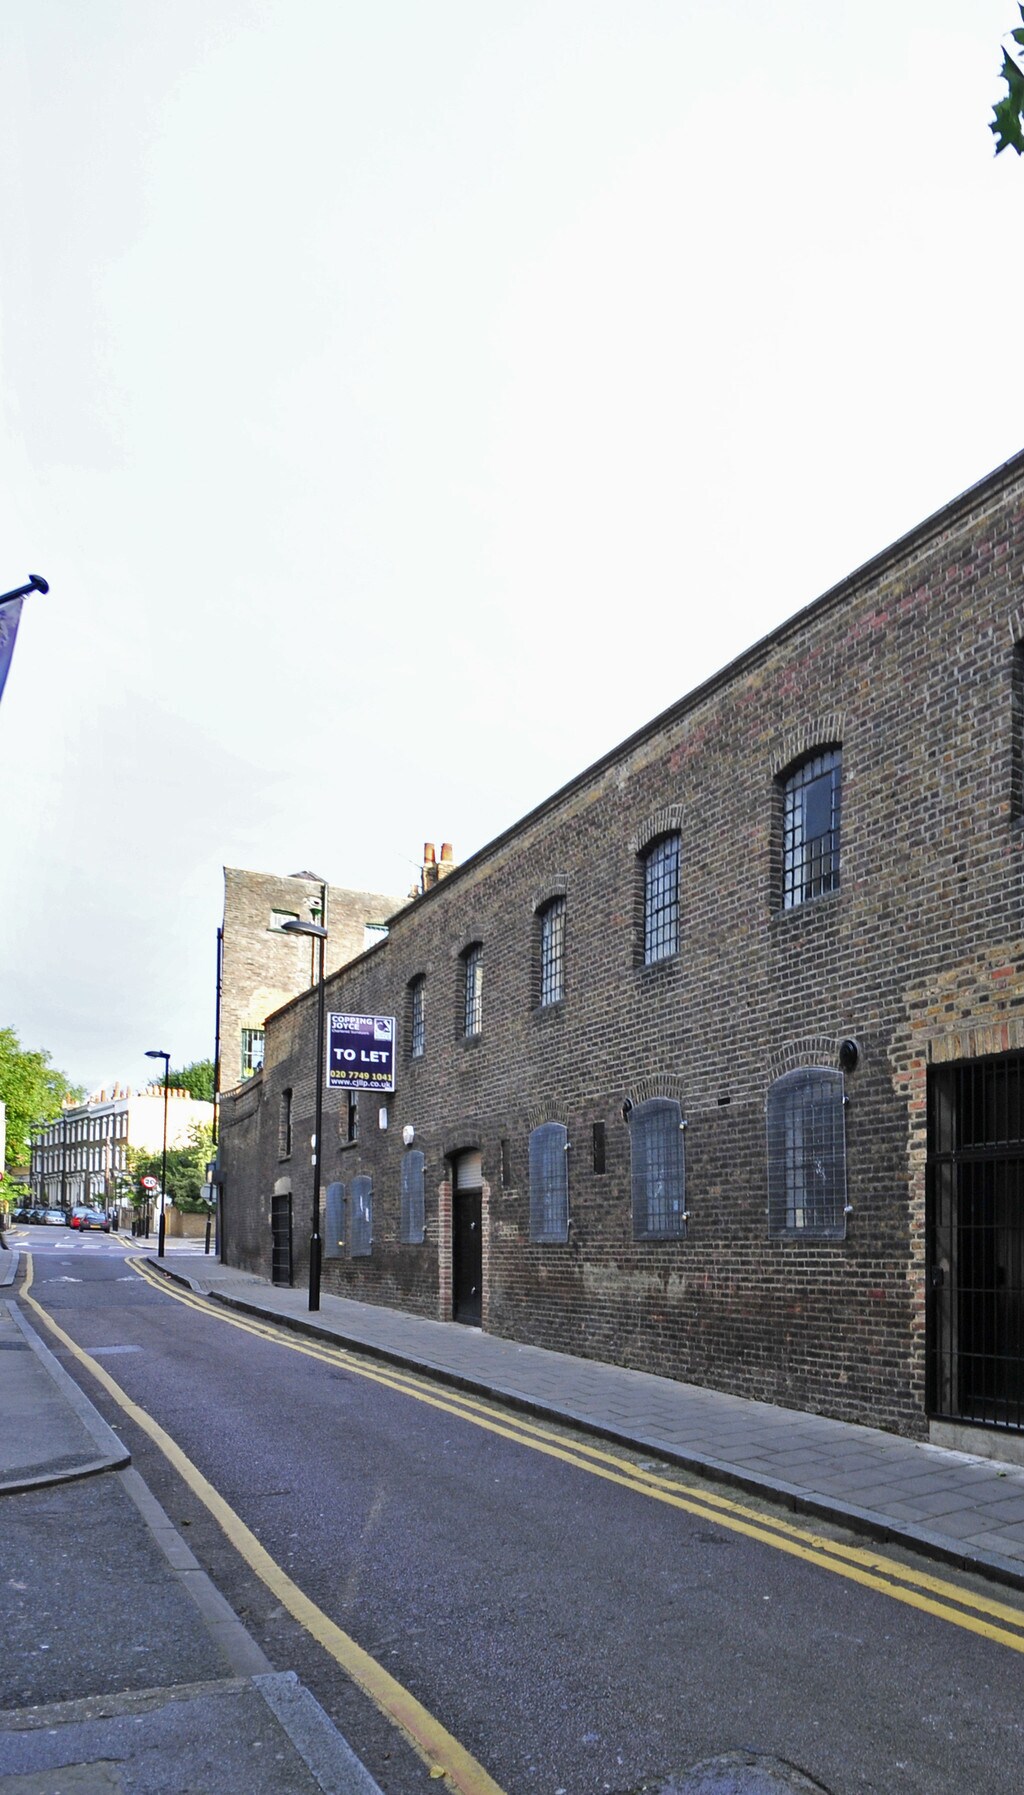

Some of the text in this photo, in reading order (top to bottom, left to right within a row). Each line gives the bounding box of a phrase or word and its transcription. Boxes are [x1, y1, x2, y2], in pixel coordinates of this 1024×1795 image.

[332, 1016, 373, 1025] COPPING
[332, 1022, 360, 1030] JOYCE
[333, 1048, 390, 1063] TO LET
[330, 1070, 392, 1081] 020 7749 1041
